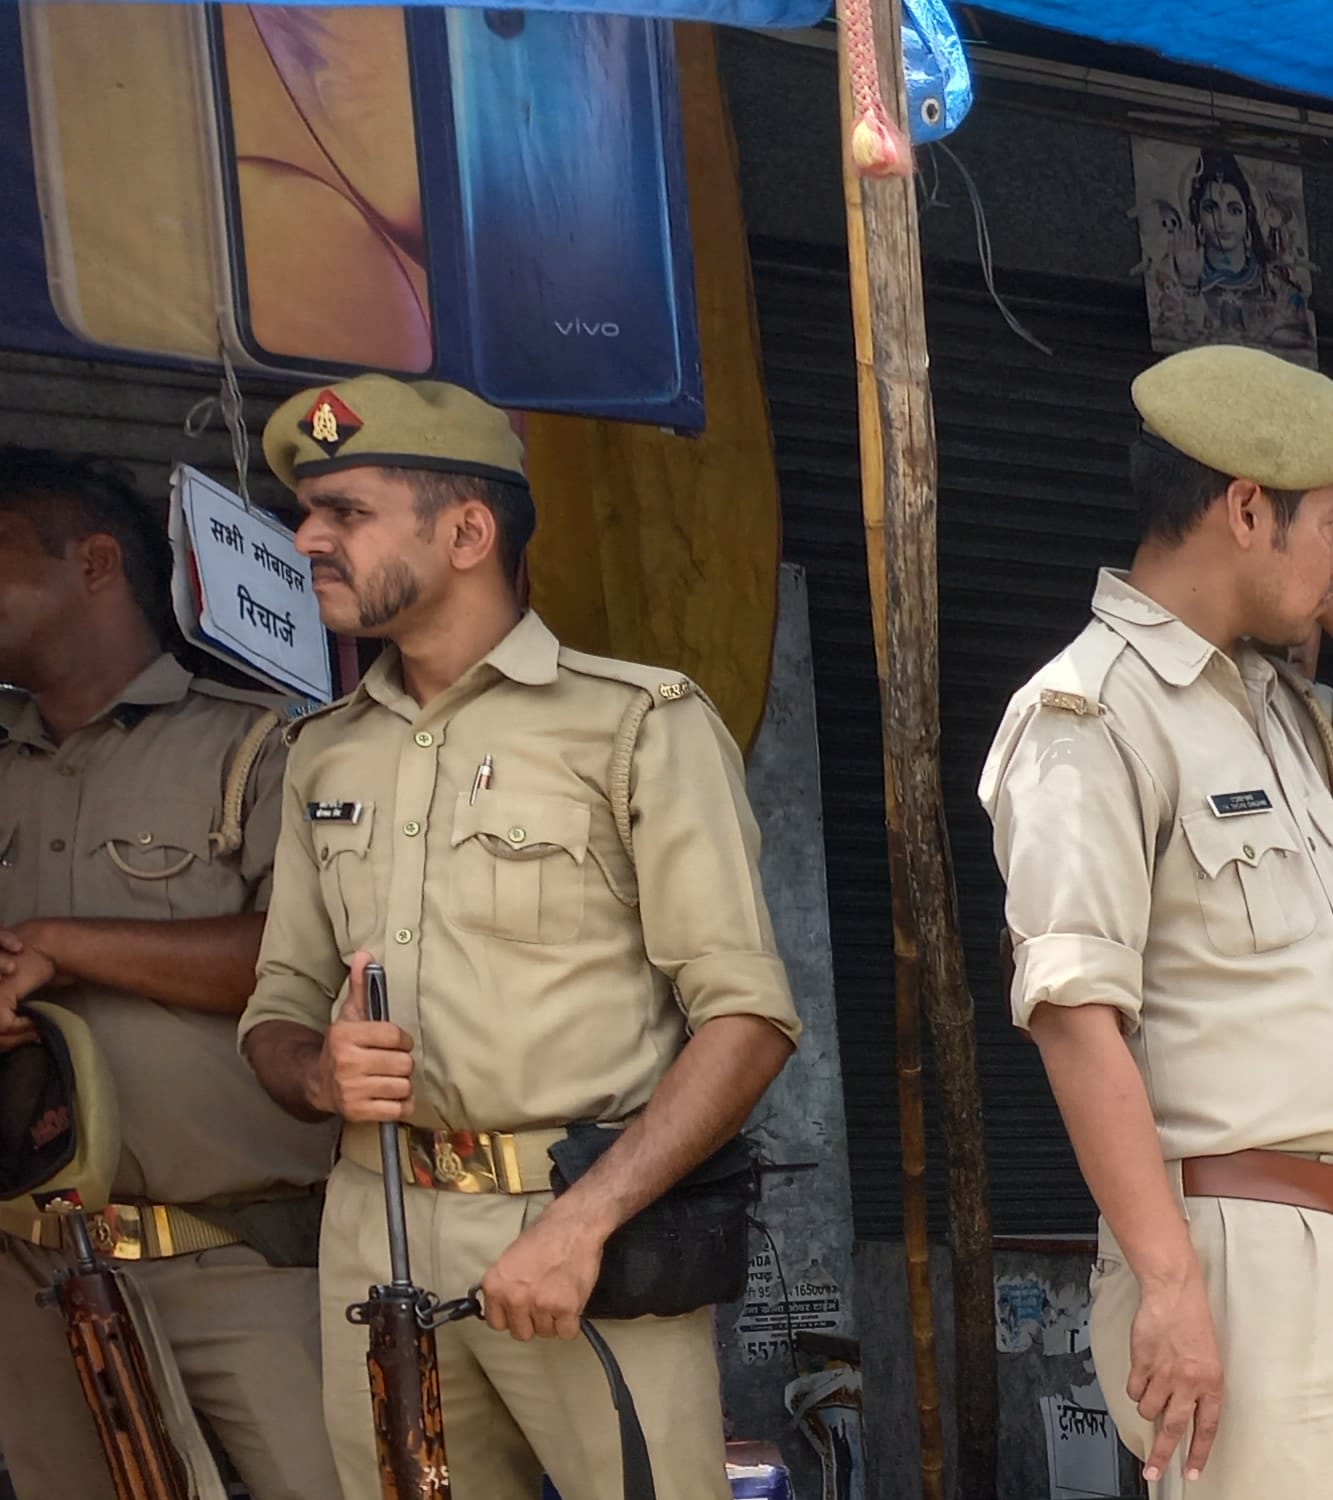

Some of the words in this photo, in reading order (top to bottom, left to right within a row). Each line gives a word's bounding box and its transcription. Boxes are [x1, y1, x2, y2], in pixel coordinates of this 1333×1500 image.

[554, 315, 620, 337] vivo
[209, 516, 244, 554] सभी
[252, 541, 305, 592] मोबाइल
[237, 584, 295, 648] रिचार्ज
